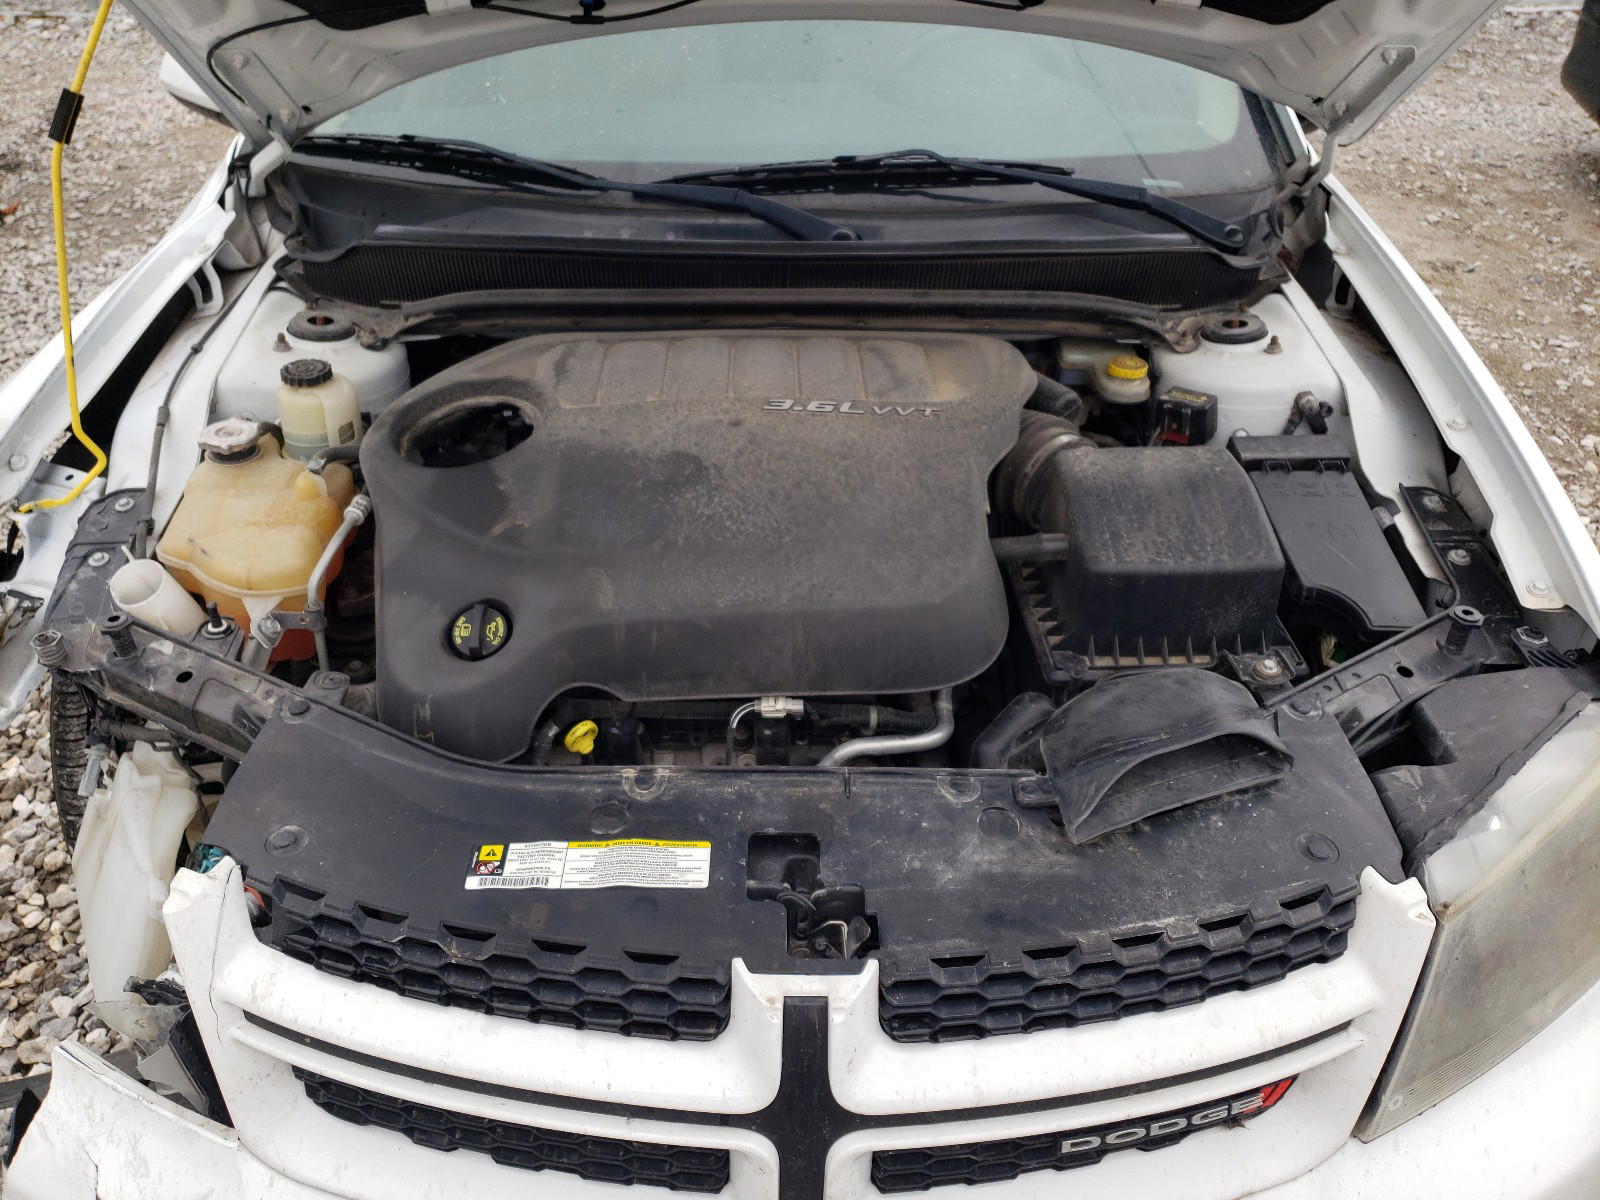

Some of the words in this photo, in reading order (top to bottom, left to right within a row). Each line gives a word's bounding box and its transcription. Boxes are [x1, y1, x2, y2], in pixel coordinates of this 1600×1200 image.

[762, 398, 865, 415] 3.6L
[872, 406, 942, 417] VVT
[1060, 1092, 1264, 1154] DODGE
